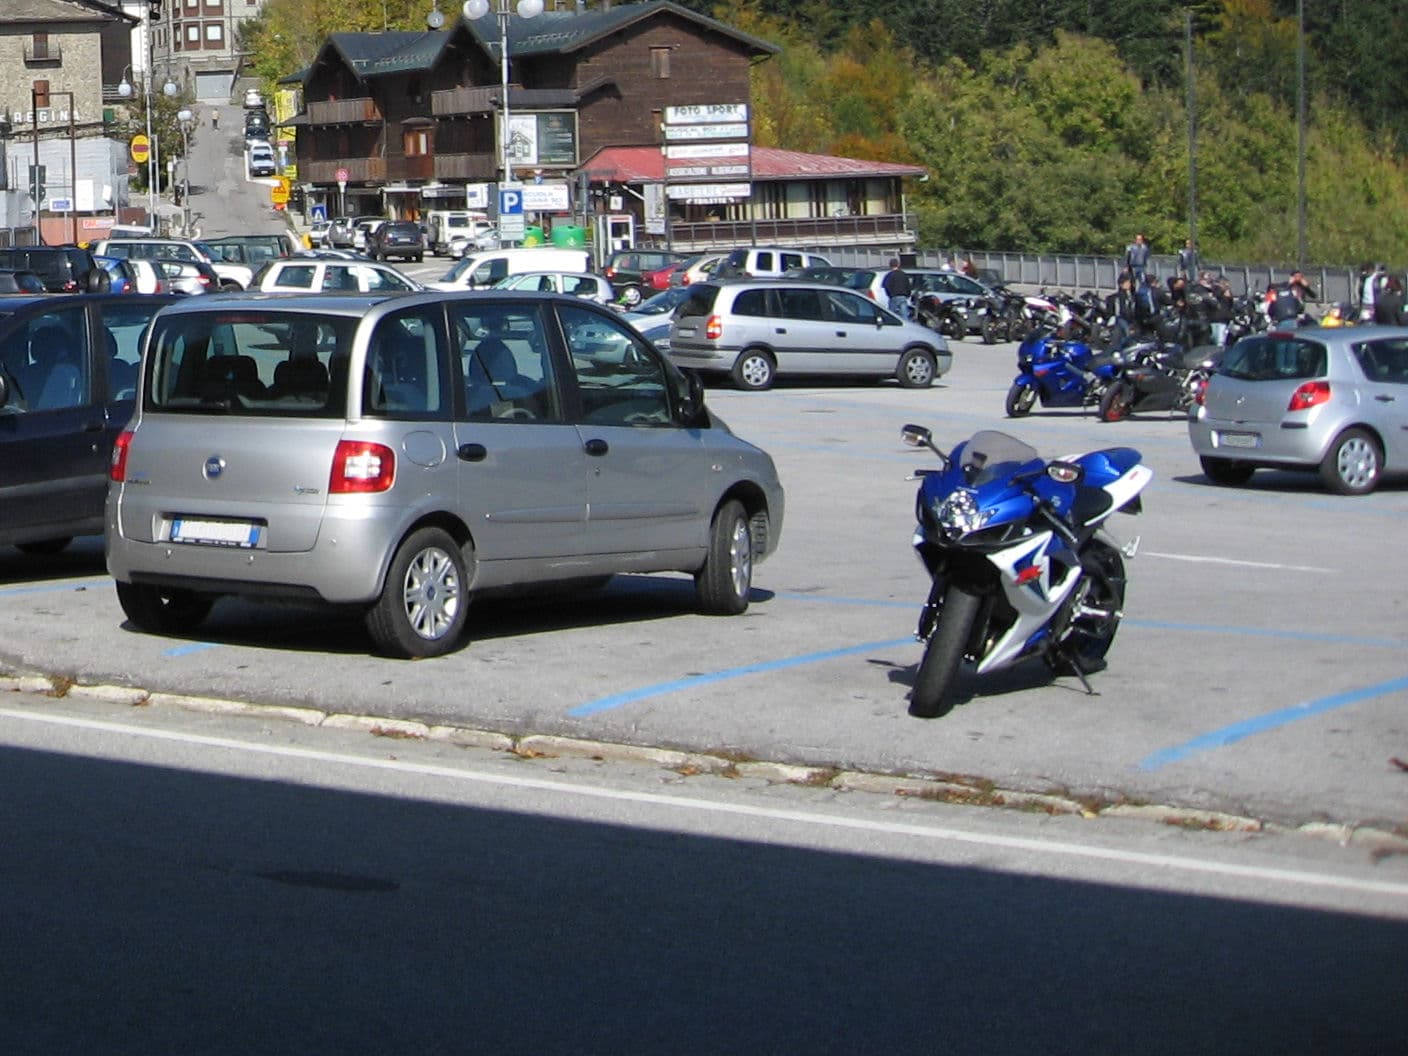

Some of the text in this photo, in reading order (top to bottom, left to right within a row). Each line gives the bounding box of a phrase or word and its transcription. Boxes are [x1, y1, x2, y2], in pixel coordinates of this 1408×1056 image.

[13, 110, 81, 123] REGINA
[674, 107, 700, 116] FOTO
[503, 193, 518, 213] P
